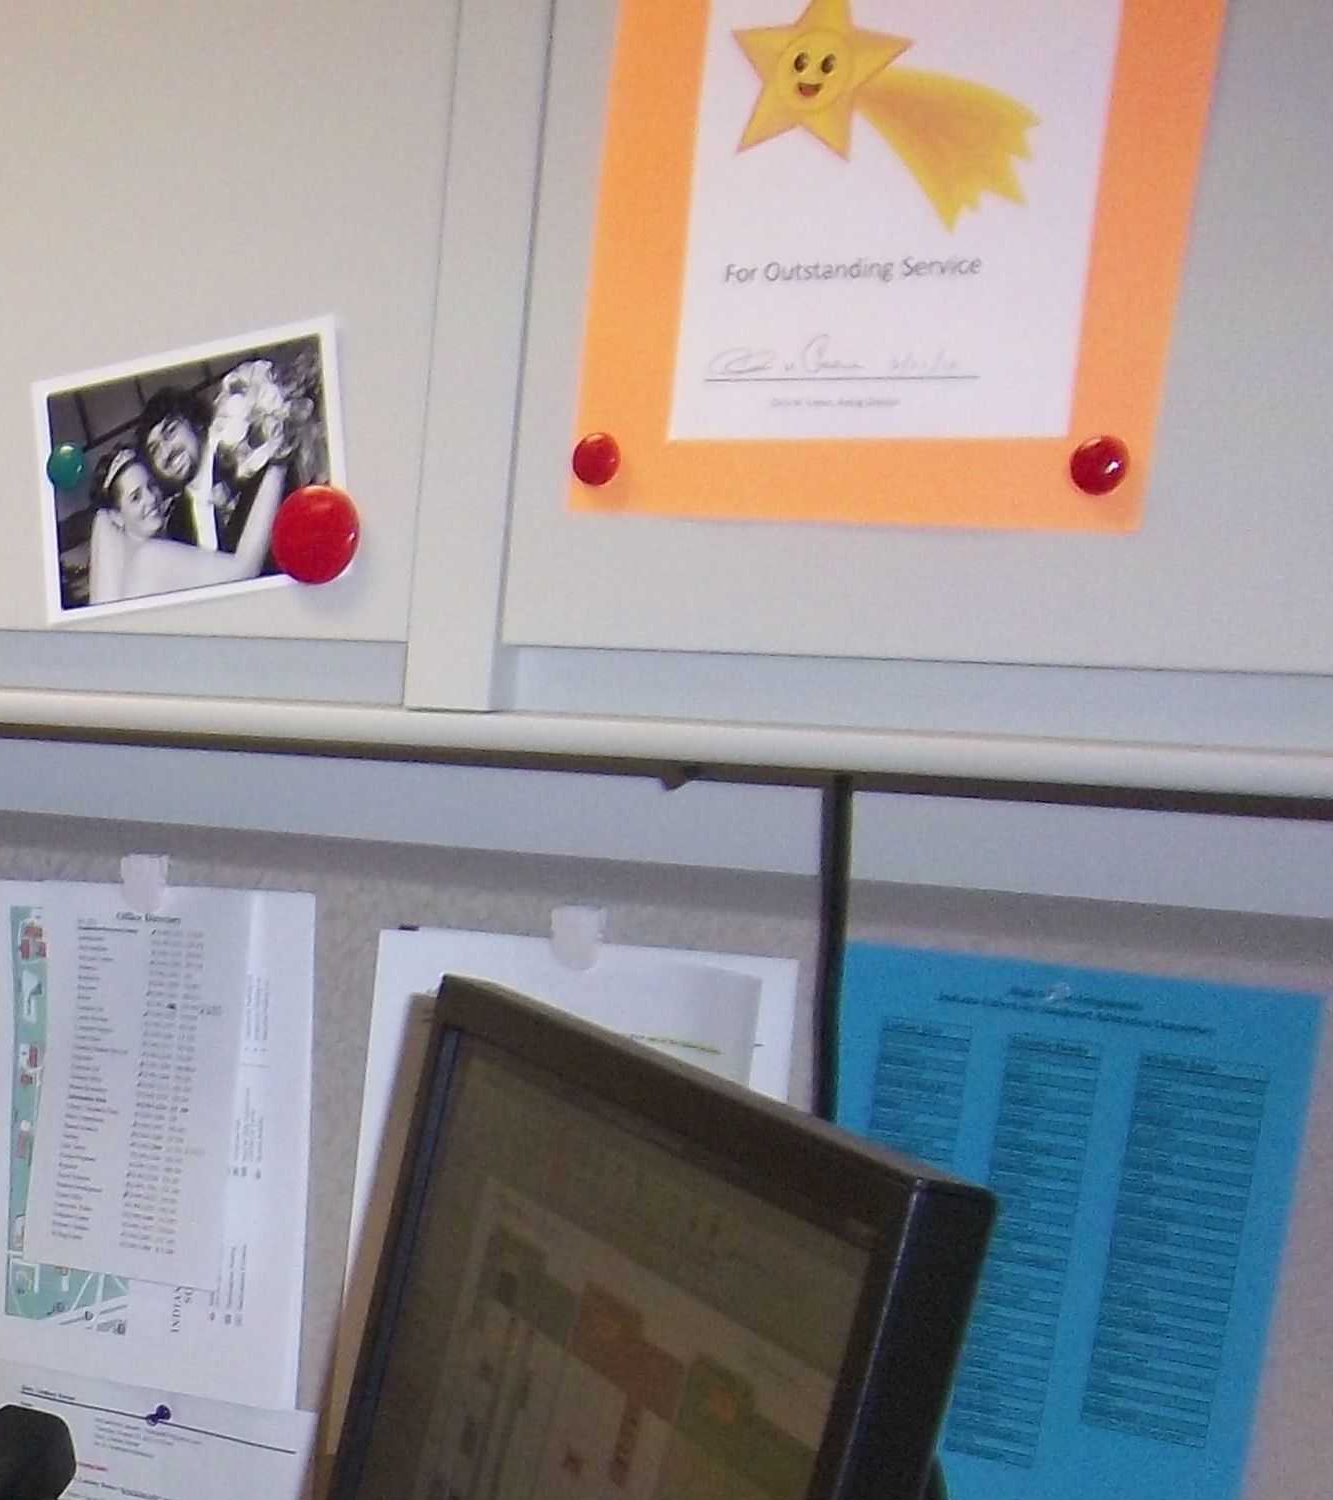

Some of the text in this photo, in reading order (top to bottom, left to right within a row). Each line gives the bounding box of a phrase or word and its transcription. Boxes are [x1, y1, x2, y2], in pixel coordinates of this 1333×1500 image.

[724, 255, 983, 284] For Outstanding Service
